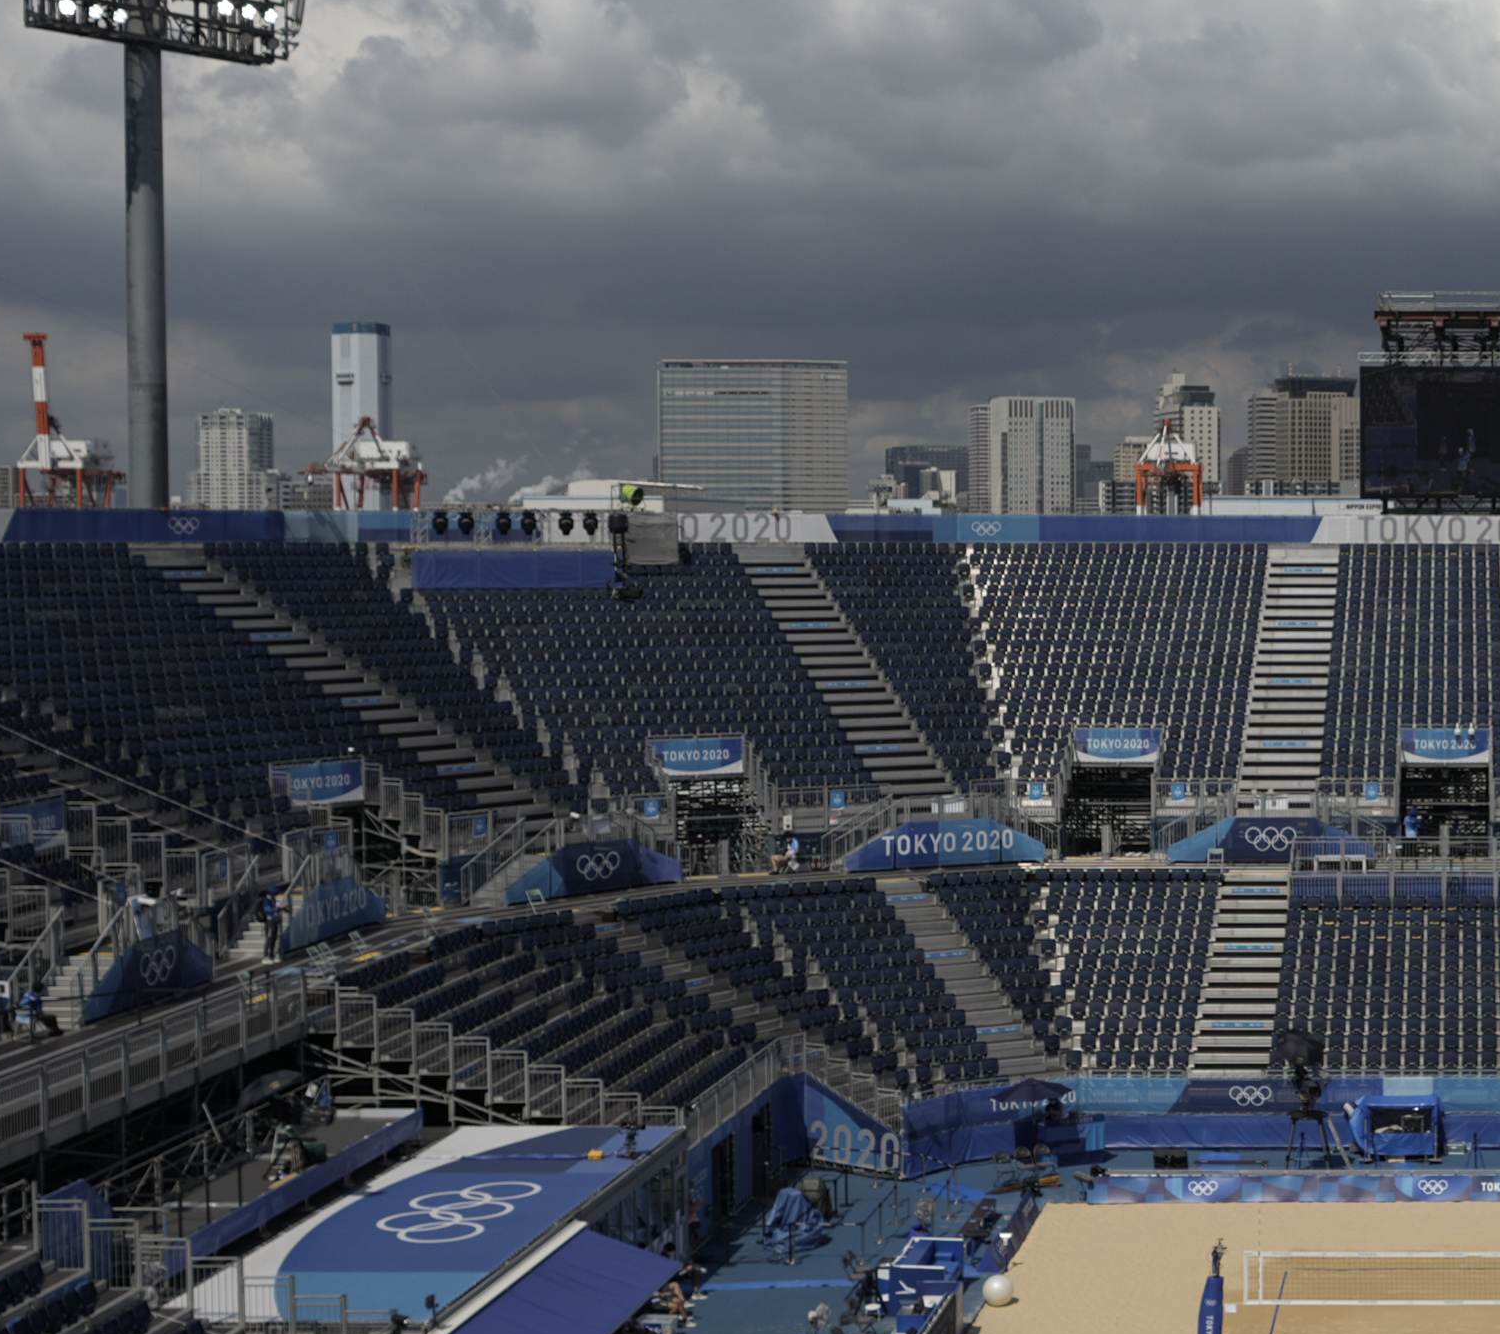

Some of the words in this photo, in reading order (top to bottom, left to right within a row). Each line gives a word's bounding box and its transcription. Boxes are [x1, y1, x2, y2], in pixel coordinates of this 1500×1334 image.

[711, 513, 792, 543] 2020
[1357, 515, 1466, 544] TOKYO
[1086, 738, 1121, 749] TOKYO
[1122, 738, 1150, 749] 2020
[1414, 739, 1448, 750] TOKYO
[662, 750, 700, 762] TOKYO
[702, 748, 730, 761] 2020
[289, 774, 323, 790] OKYO
[325, 773, 351, 787] 2020
[881, 832, 957, 857] TOKYO
[961, 829, 1014, 852] 2020
[810, 1120, 900, 1171] 2020
